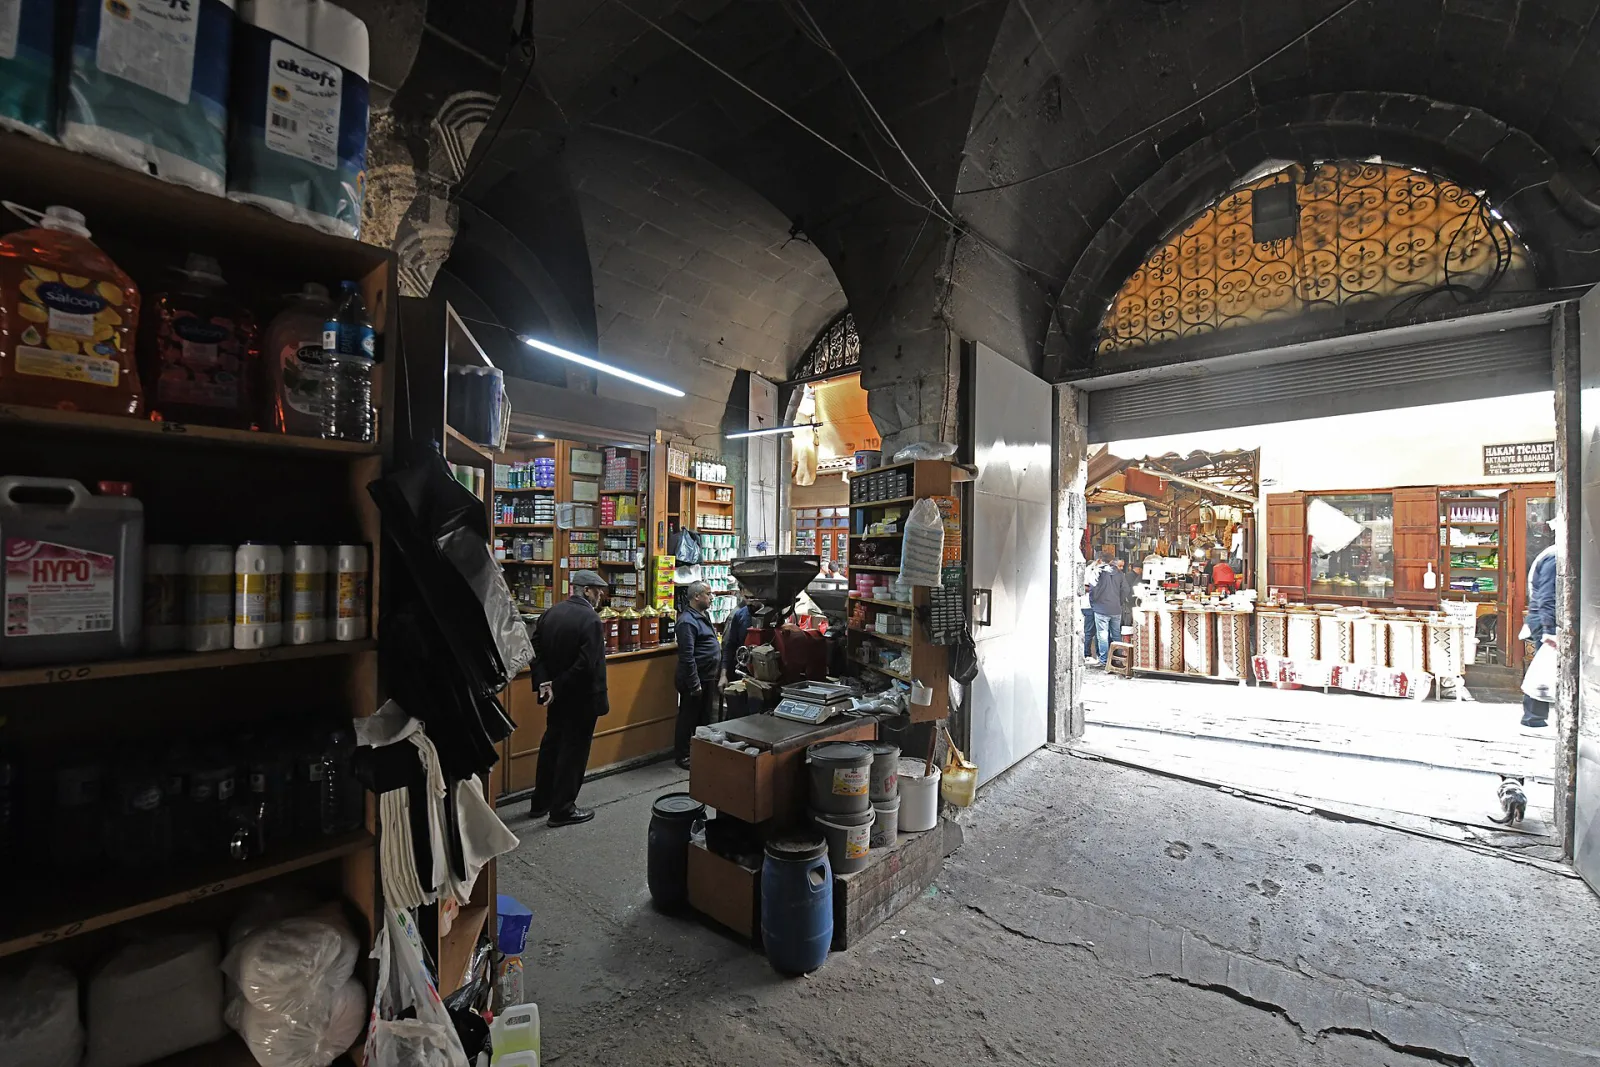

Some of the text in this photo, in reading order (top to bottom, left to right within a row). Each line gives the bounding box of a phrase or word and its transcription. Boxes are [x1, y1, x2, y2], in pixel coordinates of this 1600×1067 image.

[277, 59, 336, 88] aksoft
[45, 291, 100, 309] saloon
[1486, 444, 1553, 456] HAKAN TİCARET
[1523, 453, 1553, 461] BAHARAT
[33, 560, 90, 582] HYPO
[45, 667, 92, 683] 100
